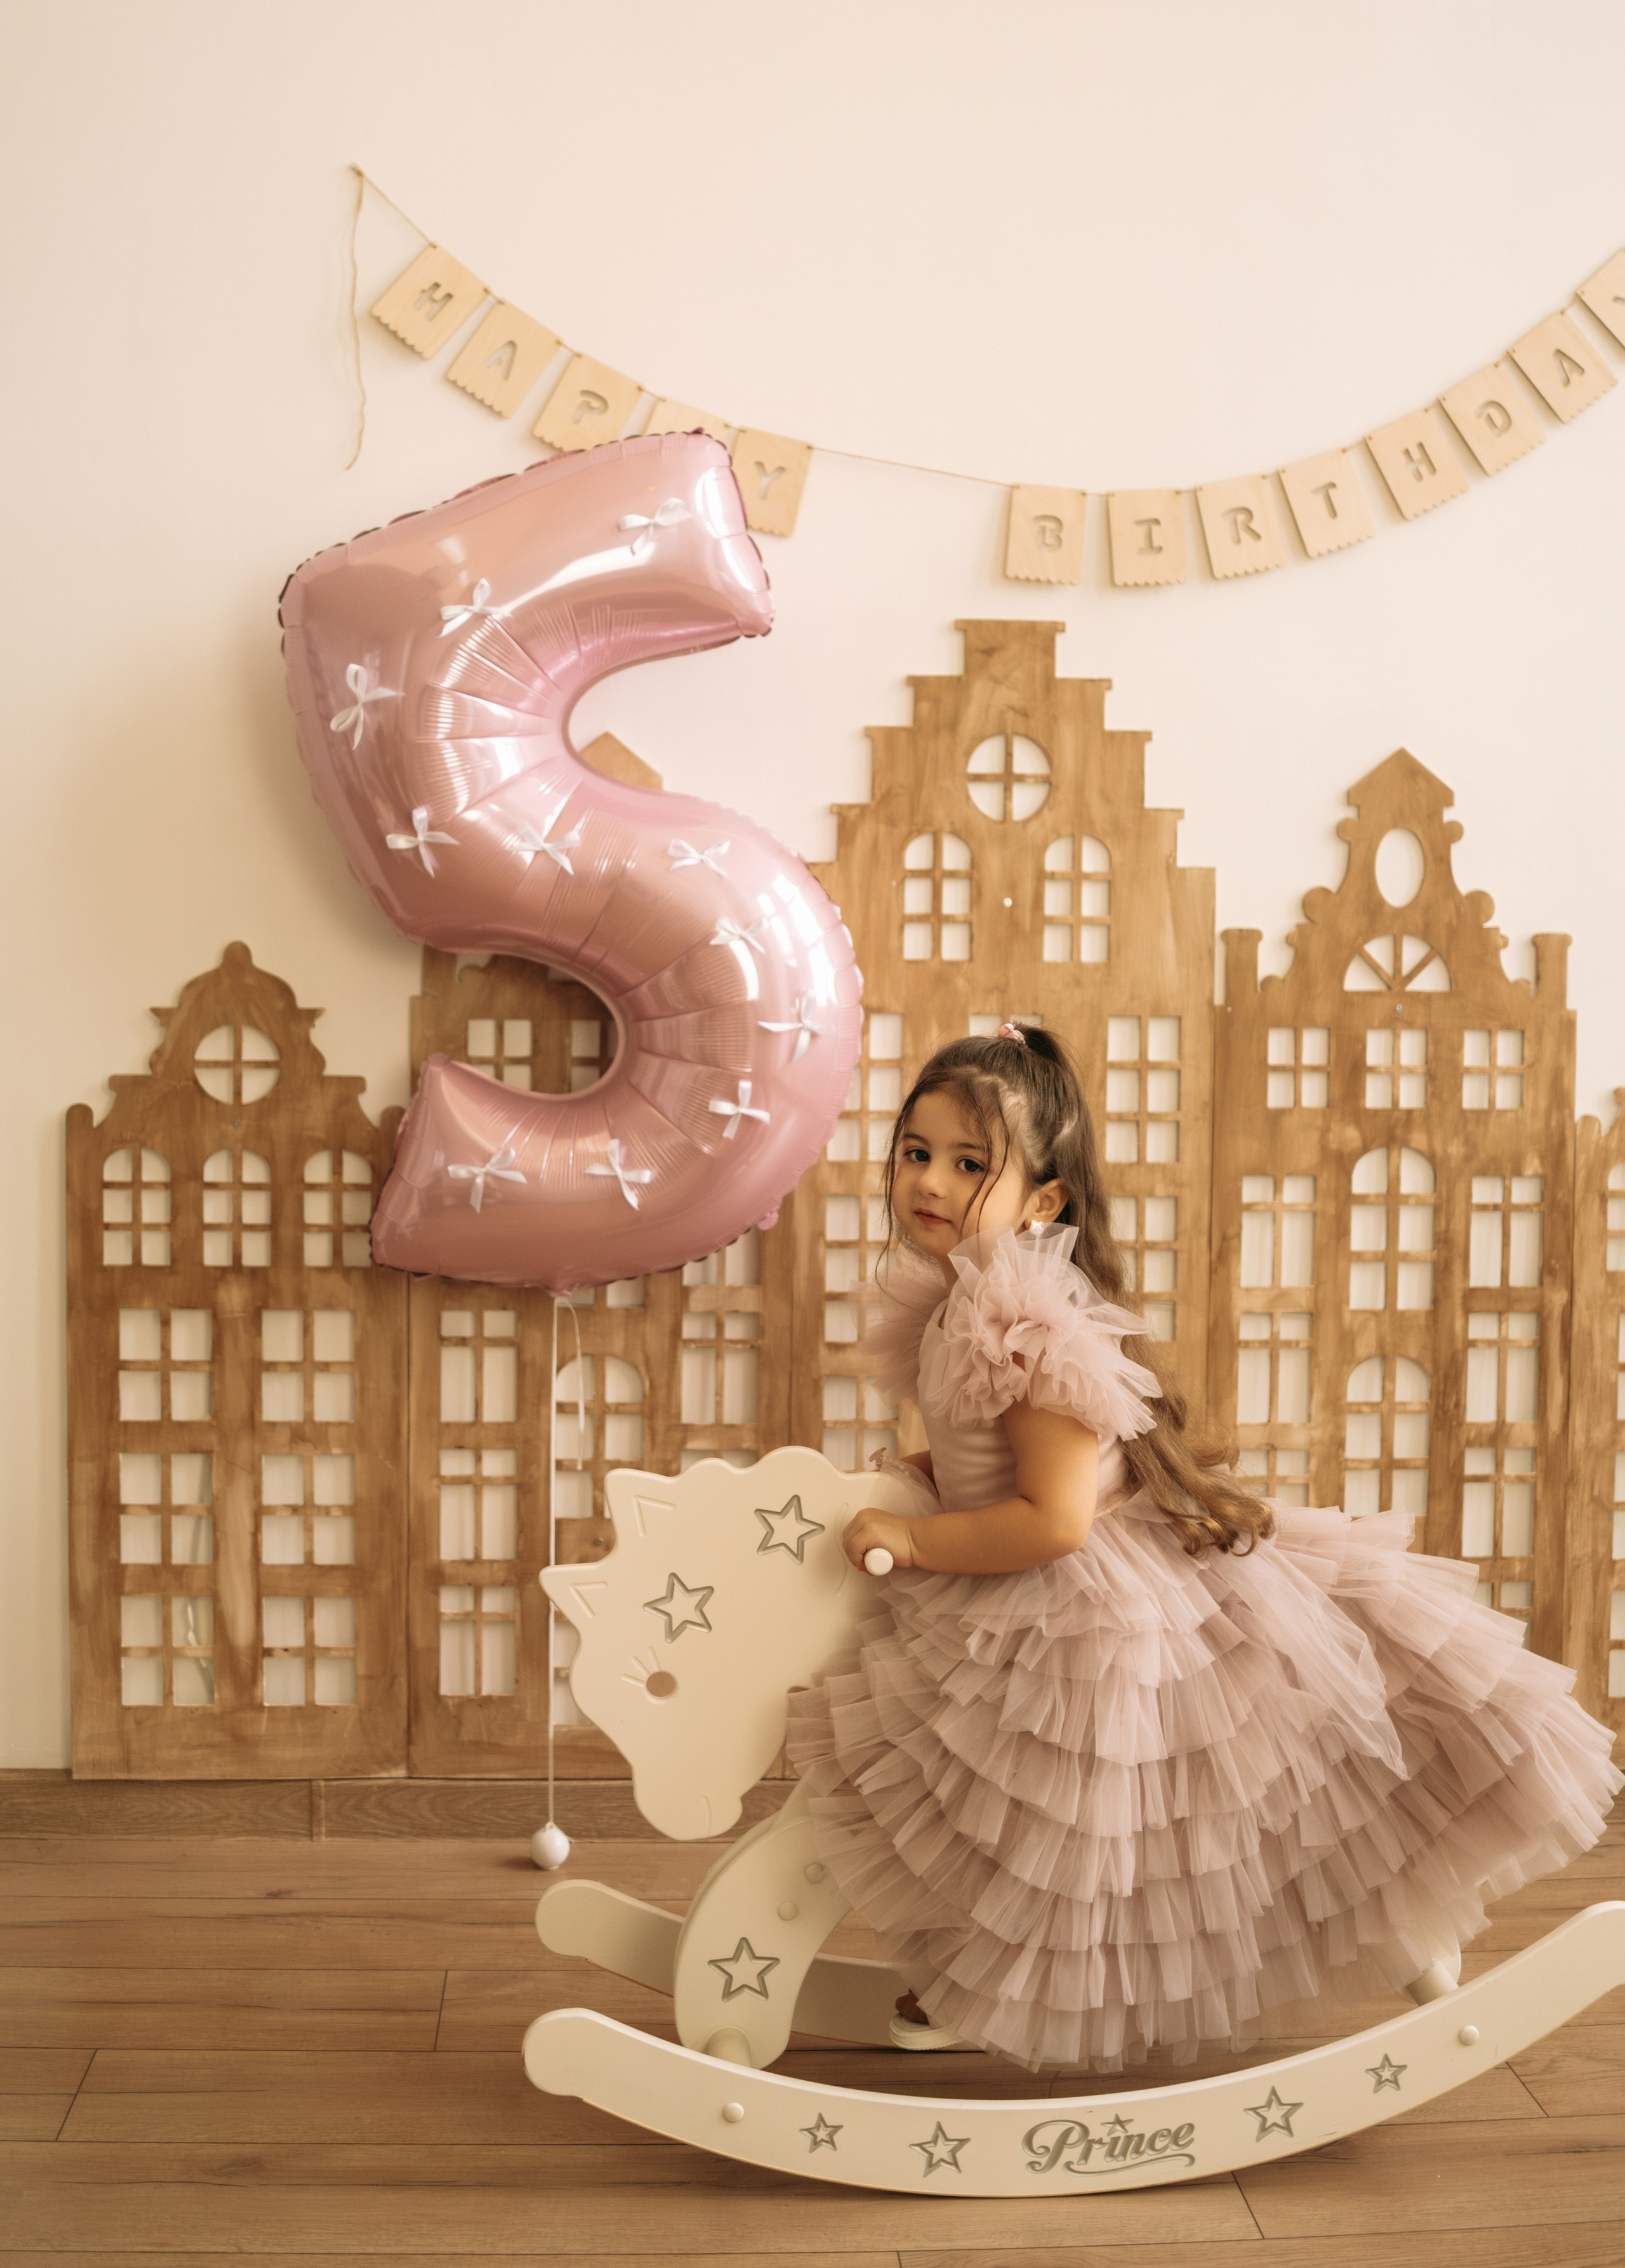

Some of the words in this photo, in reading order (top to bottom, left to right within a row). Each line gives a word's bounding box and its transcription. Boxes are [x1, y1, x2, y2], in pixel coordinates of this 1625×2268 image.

[413, 281, 786, 500] HAPY
[1033, 295, 1625, 555] BIRTHDA
[278, 426, 864, 1290] 5
[1021, 2114, 1195, 2174] Prince
